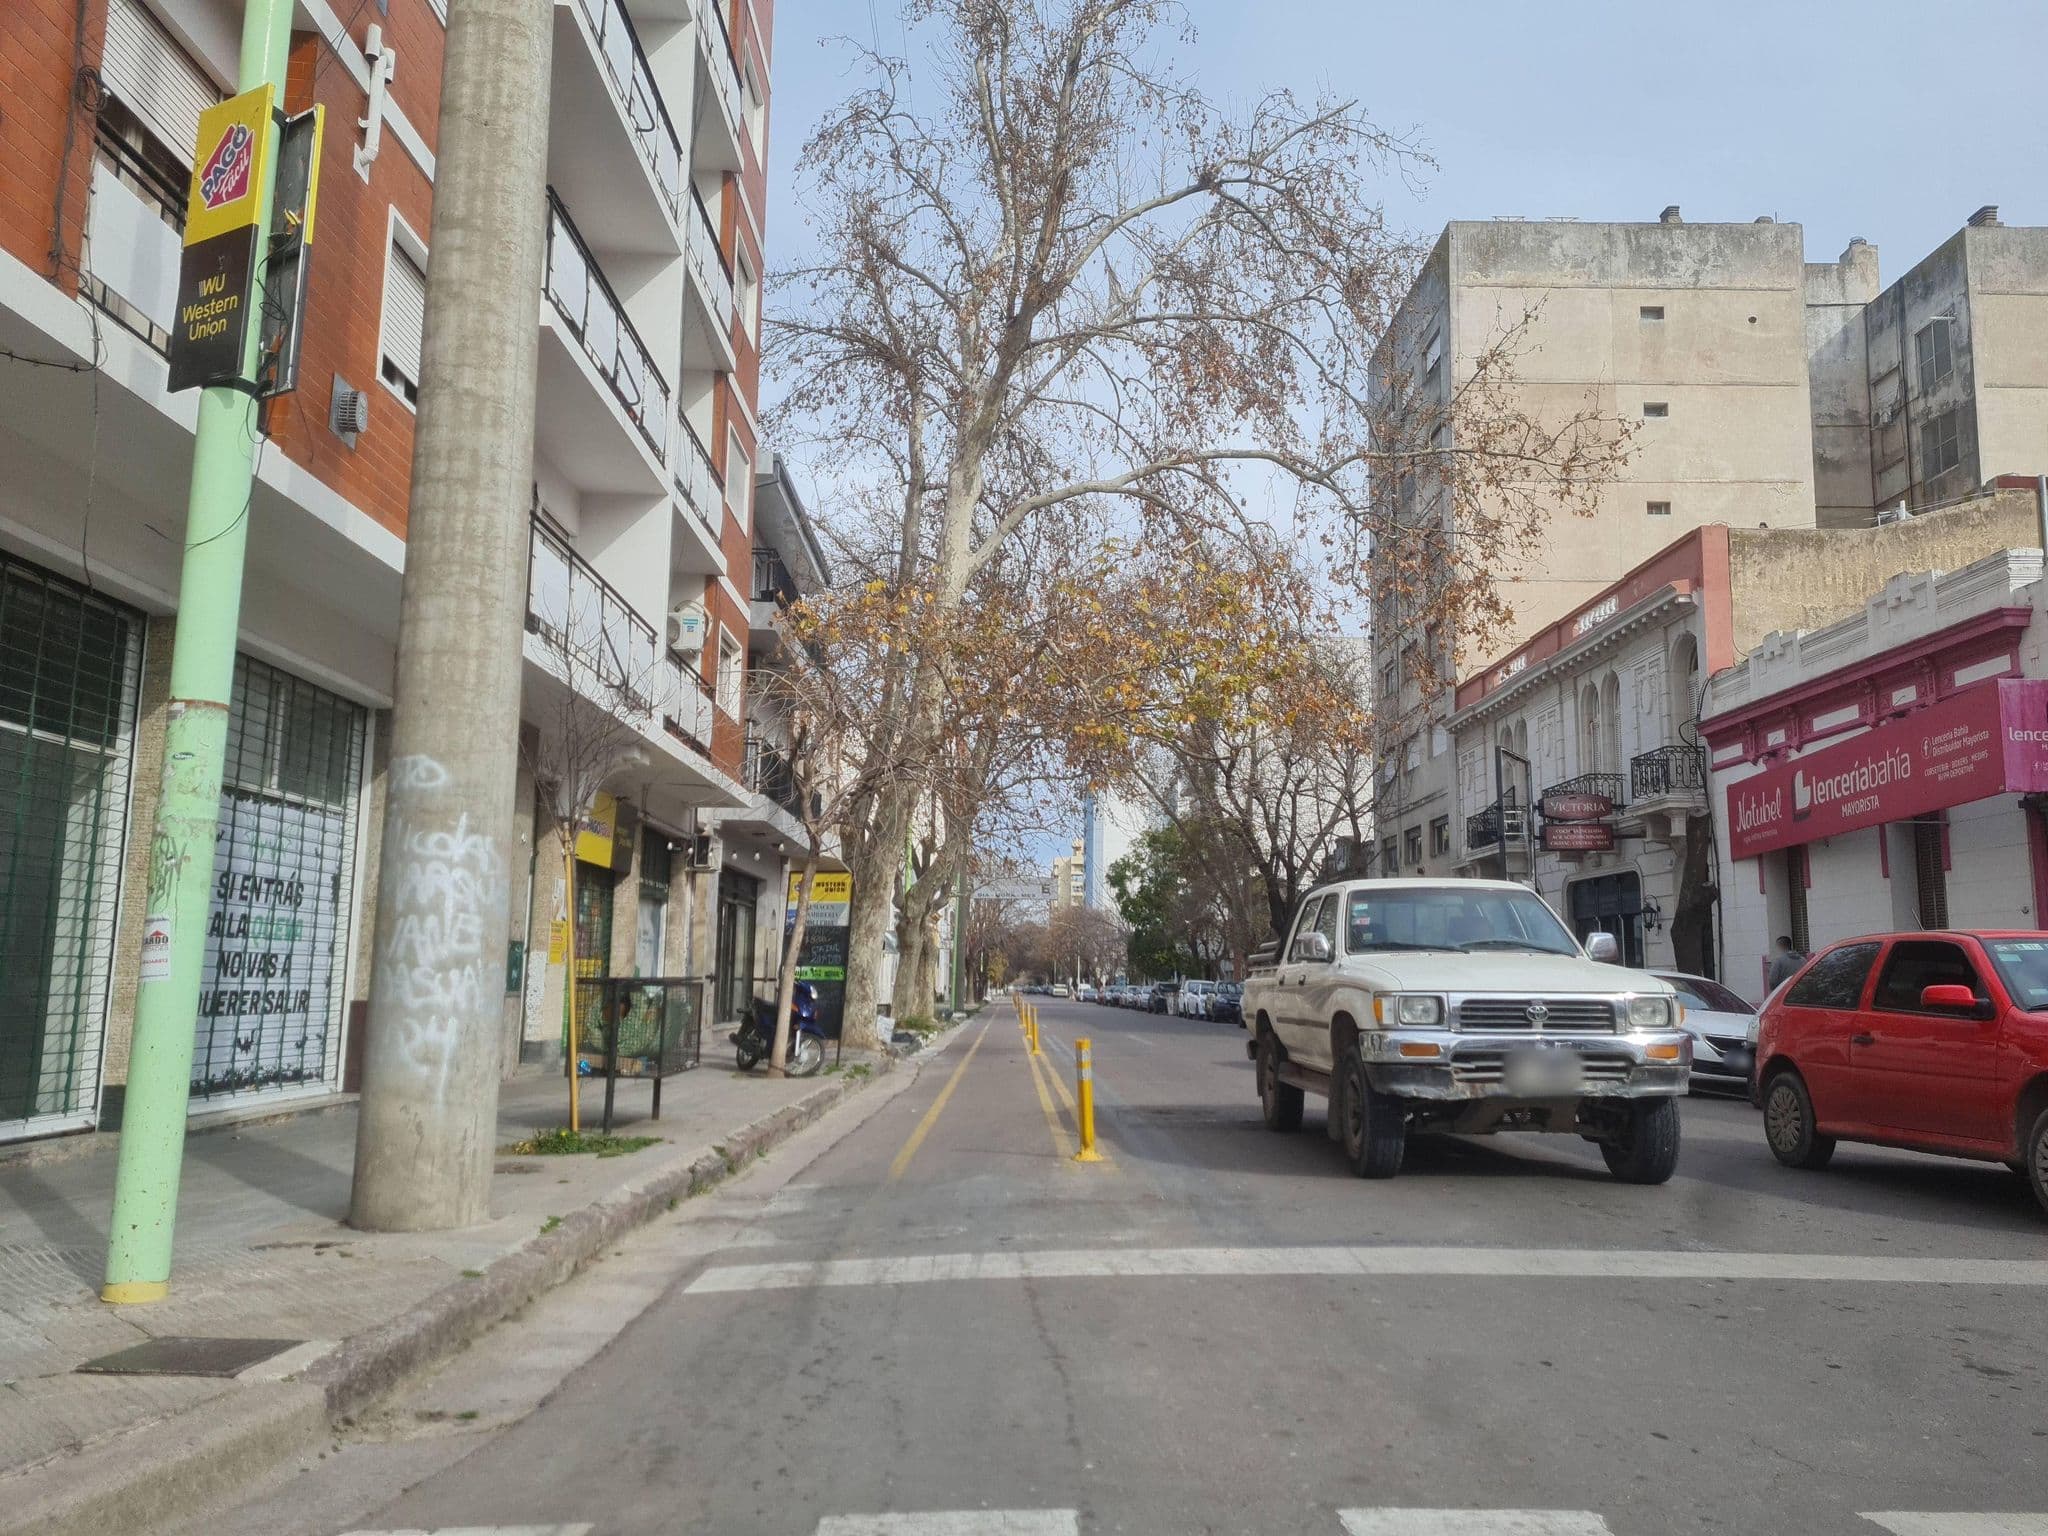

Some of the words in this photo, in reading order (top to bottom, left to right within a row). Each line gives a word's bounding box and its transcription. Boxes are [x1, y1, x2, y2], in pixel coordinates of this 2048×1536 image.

[201, 124, 249, 203] PAGO
[220, 148, 250, 201] Fácil
[201, 273, 226, 294] WU
[183, 294, 239, 324] Western
[189, 317, 228, 340] Union
[1550, 802, 1606, 812] VICTORIA
[1736, 787, 1783, 833] Natubel
[1841, 794, 1880, 818] MAYORISTA
[217, 872, 236, 901] SI
[239, 872, 304, 907] ENTRÁS
[209, 911, 222, 937] A
[227, 913, 248, 938] LA
[216, 951, 241, 978] NO
[248, 951, 279, 978] VAS
[280, 953, 292, 978] A
[263, 989, 311, 1015] SALIR
